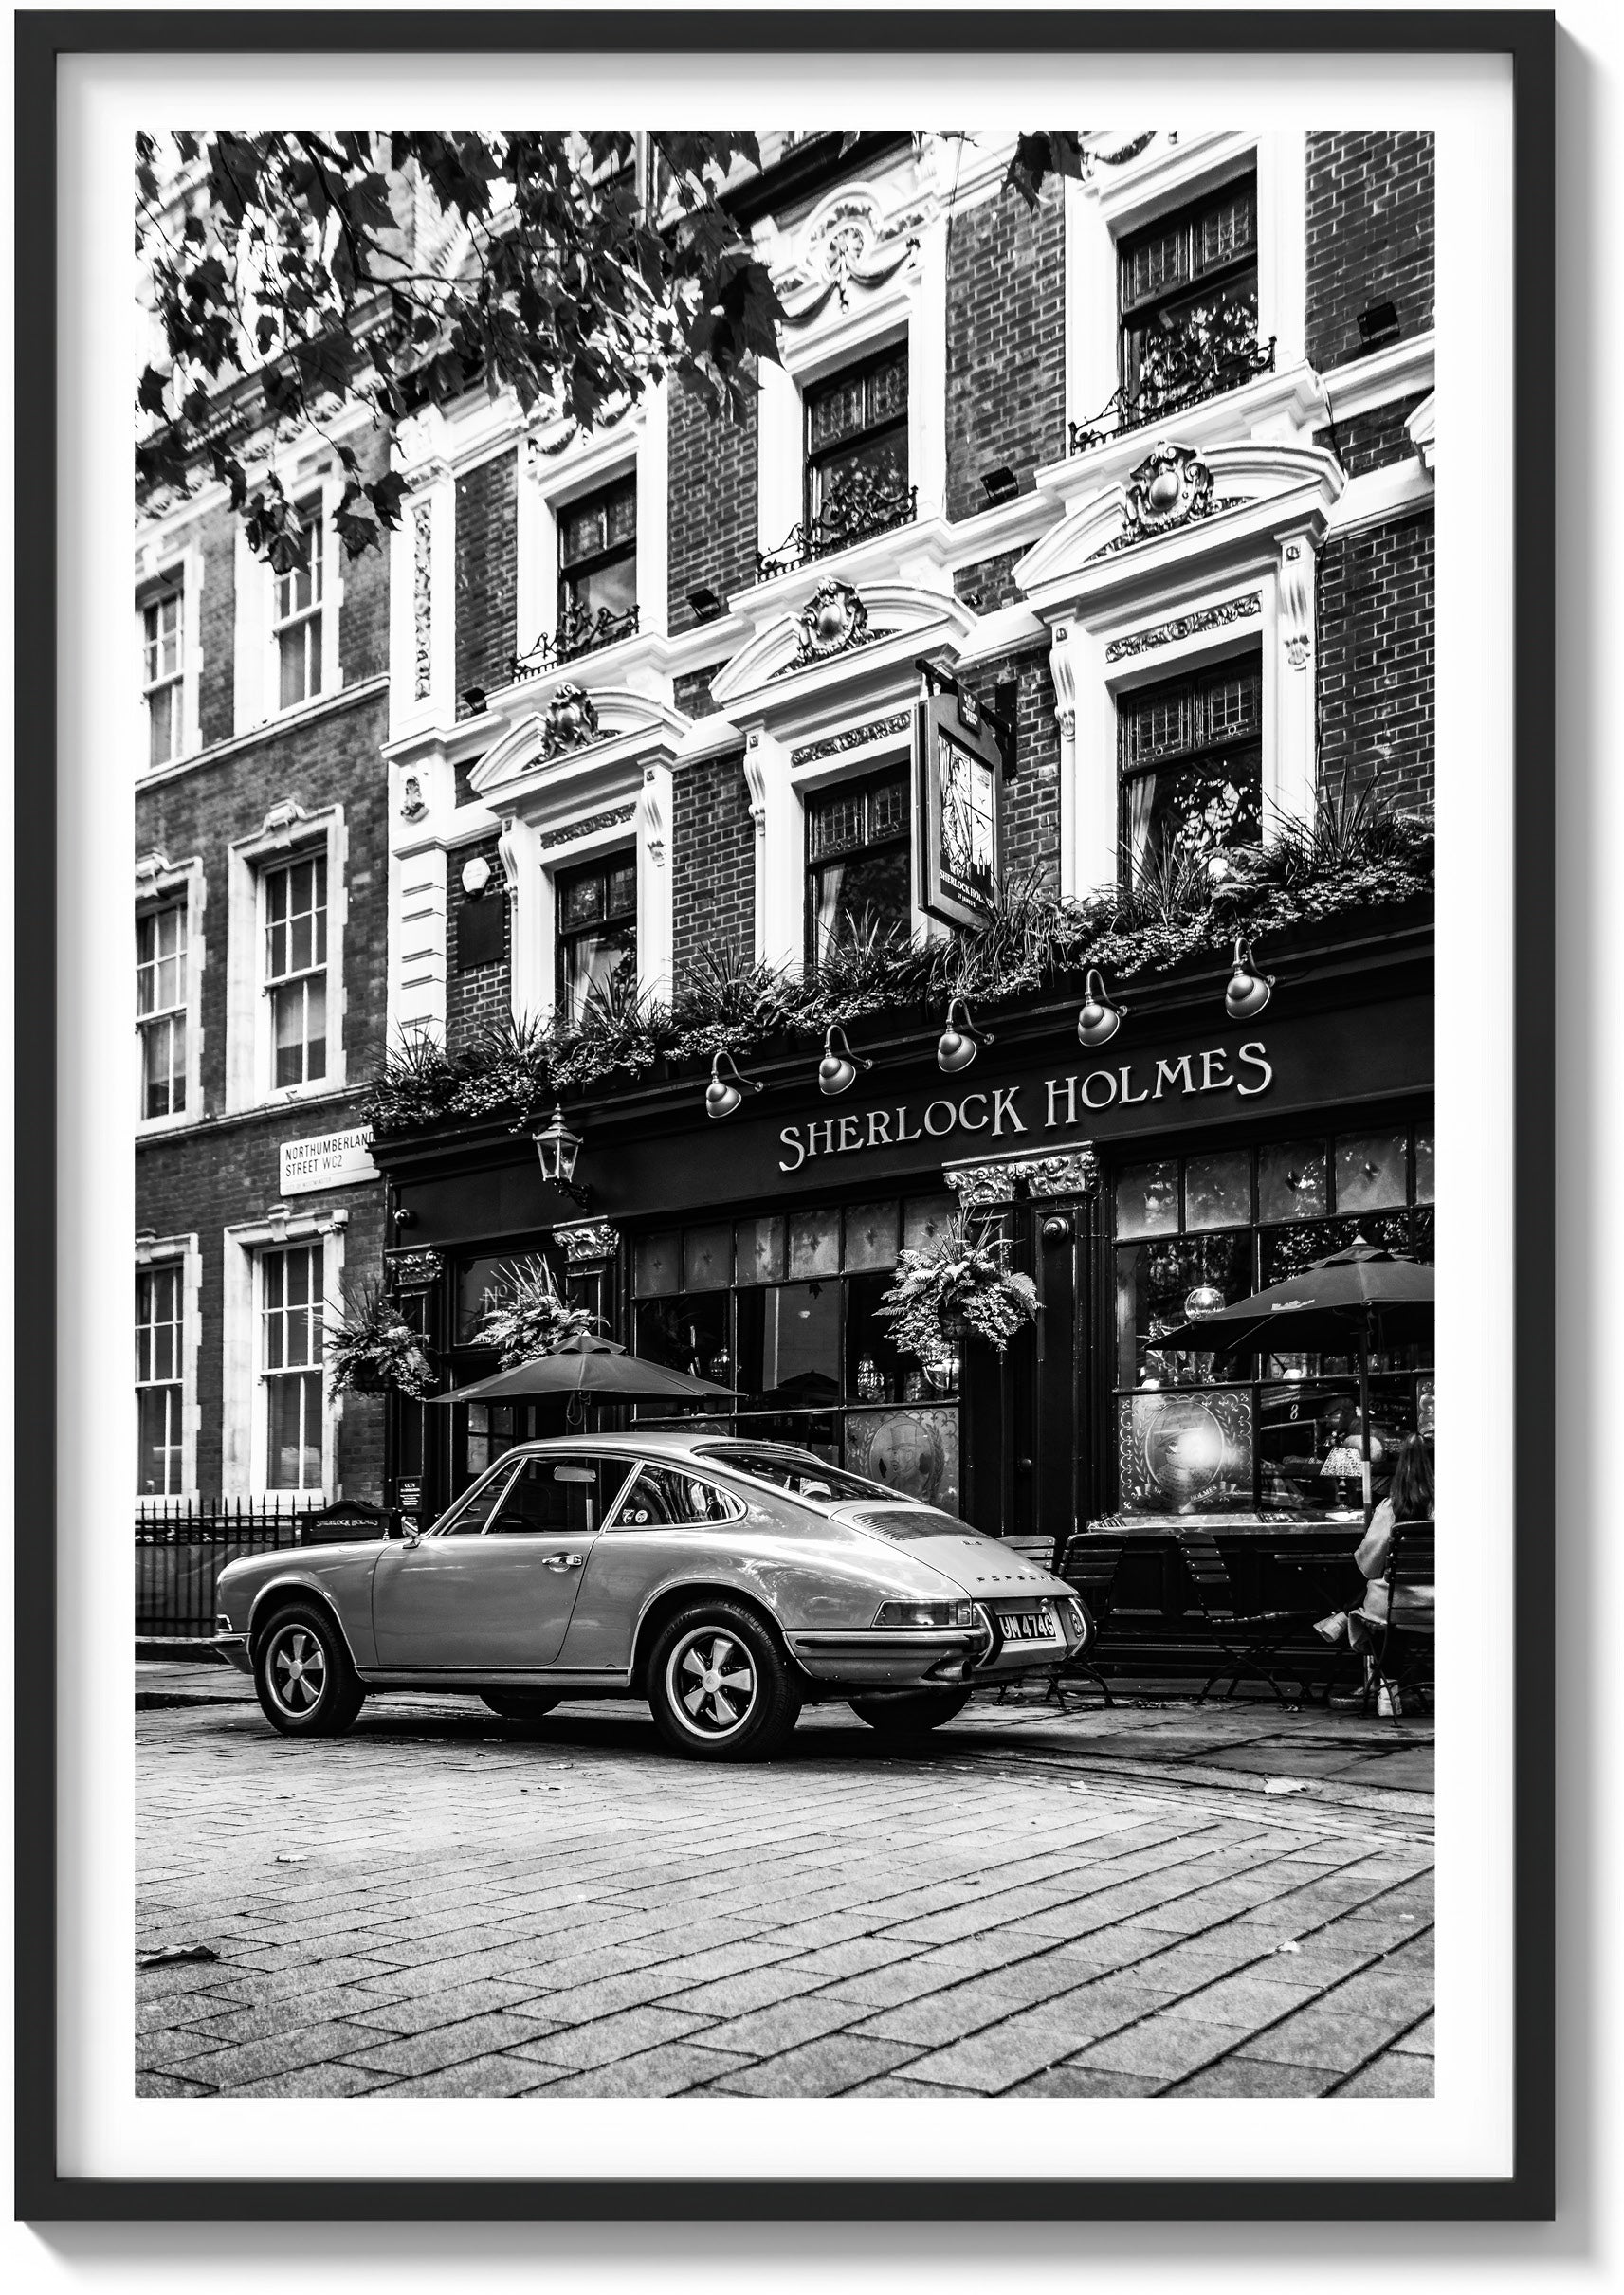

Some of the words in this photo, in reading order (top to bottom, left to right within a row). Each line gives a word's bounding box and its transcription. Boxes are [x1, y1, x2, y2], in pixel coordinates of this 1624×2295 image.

[940, 868, 971, 895] SHERLOCK
[777, 1086, 1027, 1172] SHERLOCK
[1044, 1042, 1274, 1128] HOLMES
[285, 1158, 319, 1177] STREET
[322, 1154, 343, 1170] WC2
[1022, 1614, 1056, 1637] 474G
